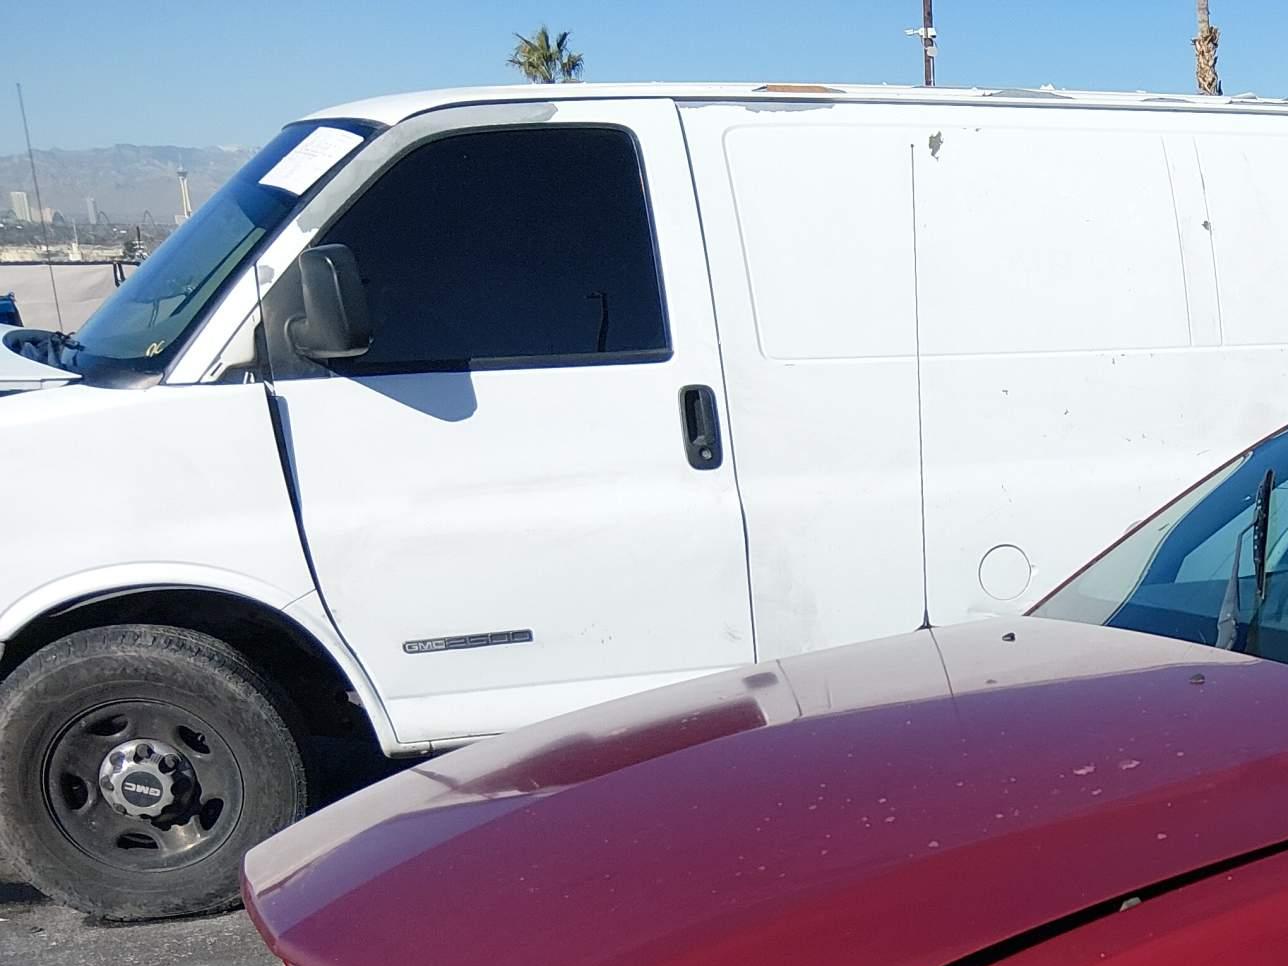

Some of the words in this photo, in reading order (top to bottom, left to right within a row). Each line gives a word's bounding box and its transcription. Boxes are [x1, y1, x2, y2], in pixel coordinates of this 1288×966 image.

[405, 640, 446, 652] GMC
[446, 631, 532, 648] 2500
[124, 782, 161, 797] GMC
